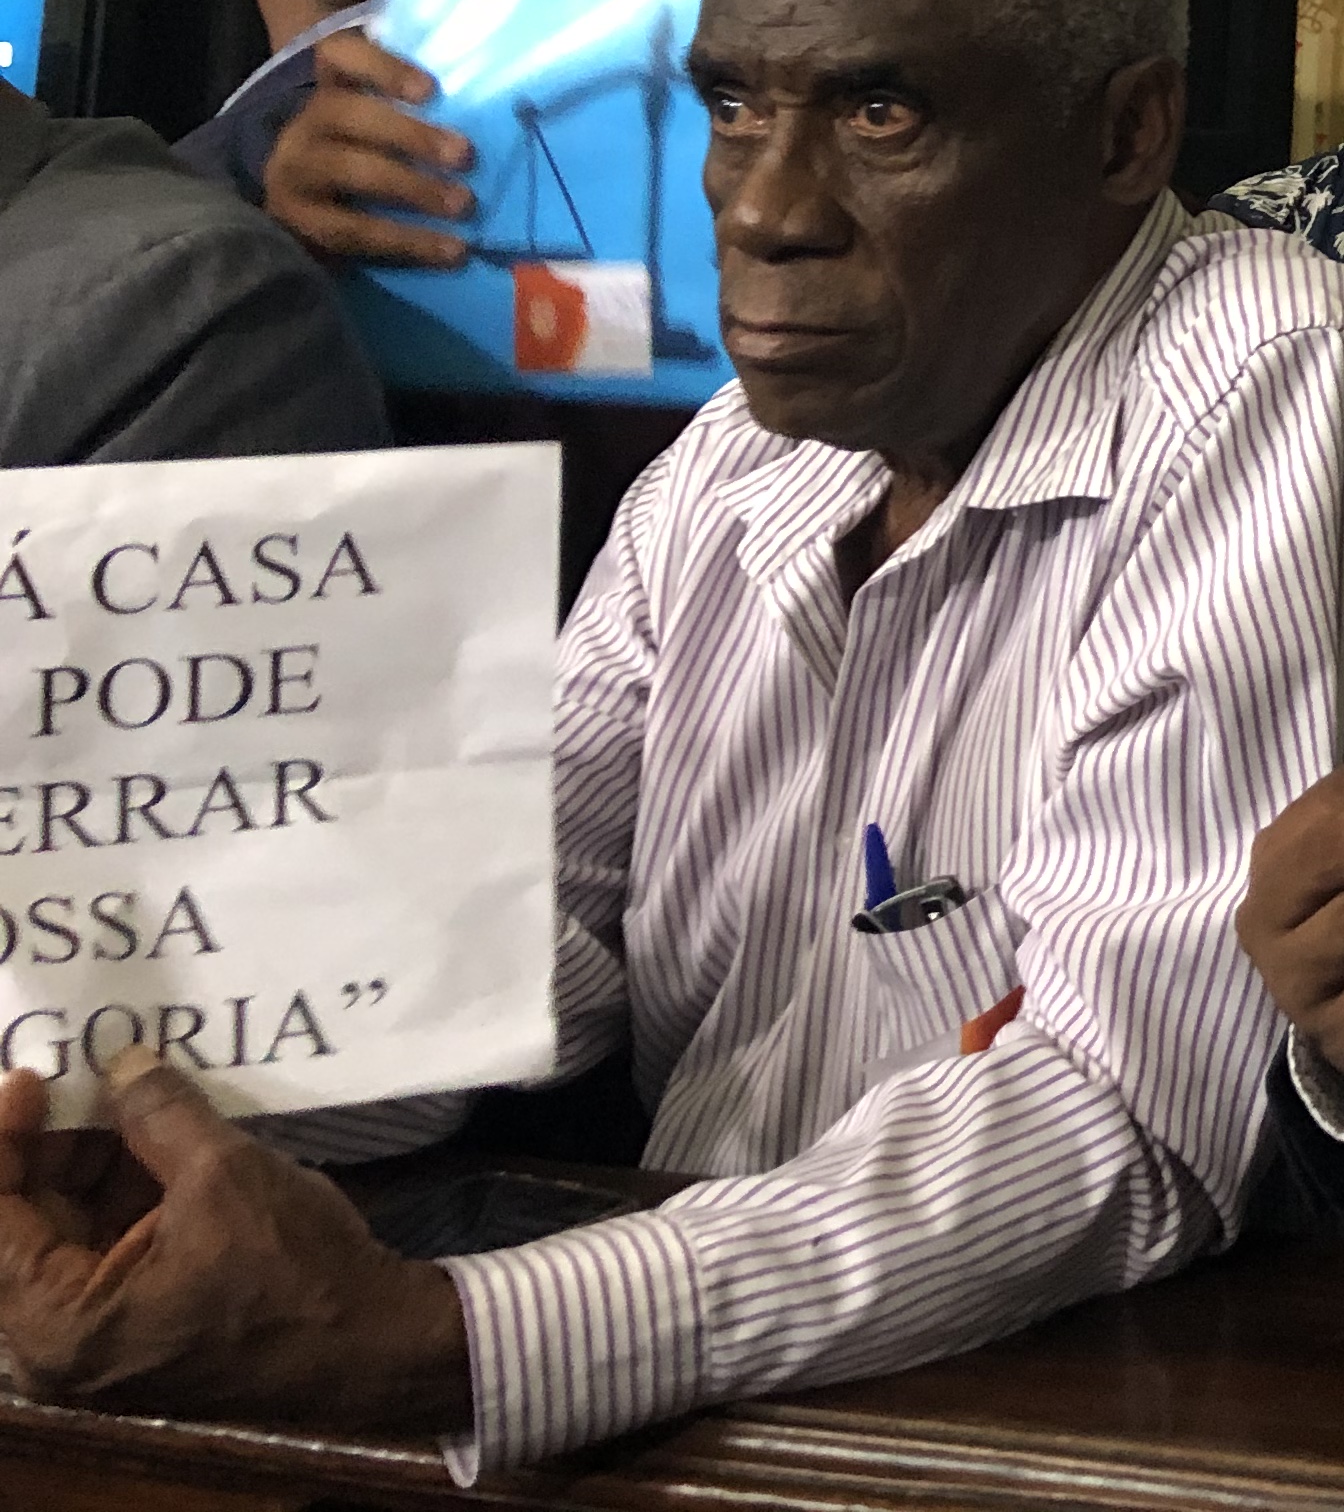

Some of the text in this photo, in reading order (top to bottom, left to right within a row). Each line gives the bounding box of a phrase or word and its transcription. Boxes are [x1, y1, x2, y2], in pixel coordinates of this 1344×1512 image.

[90, 531, 381, 617] CASA
[29, 643, 322, 738] PODE
[0, 886, 223, 965] SSA
